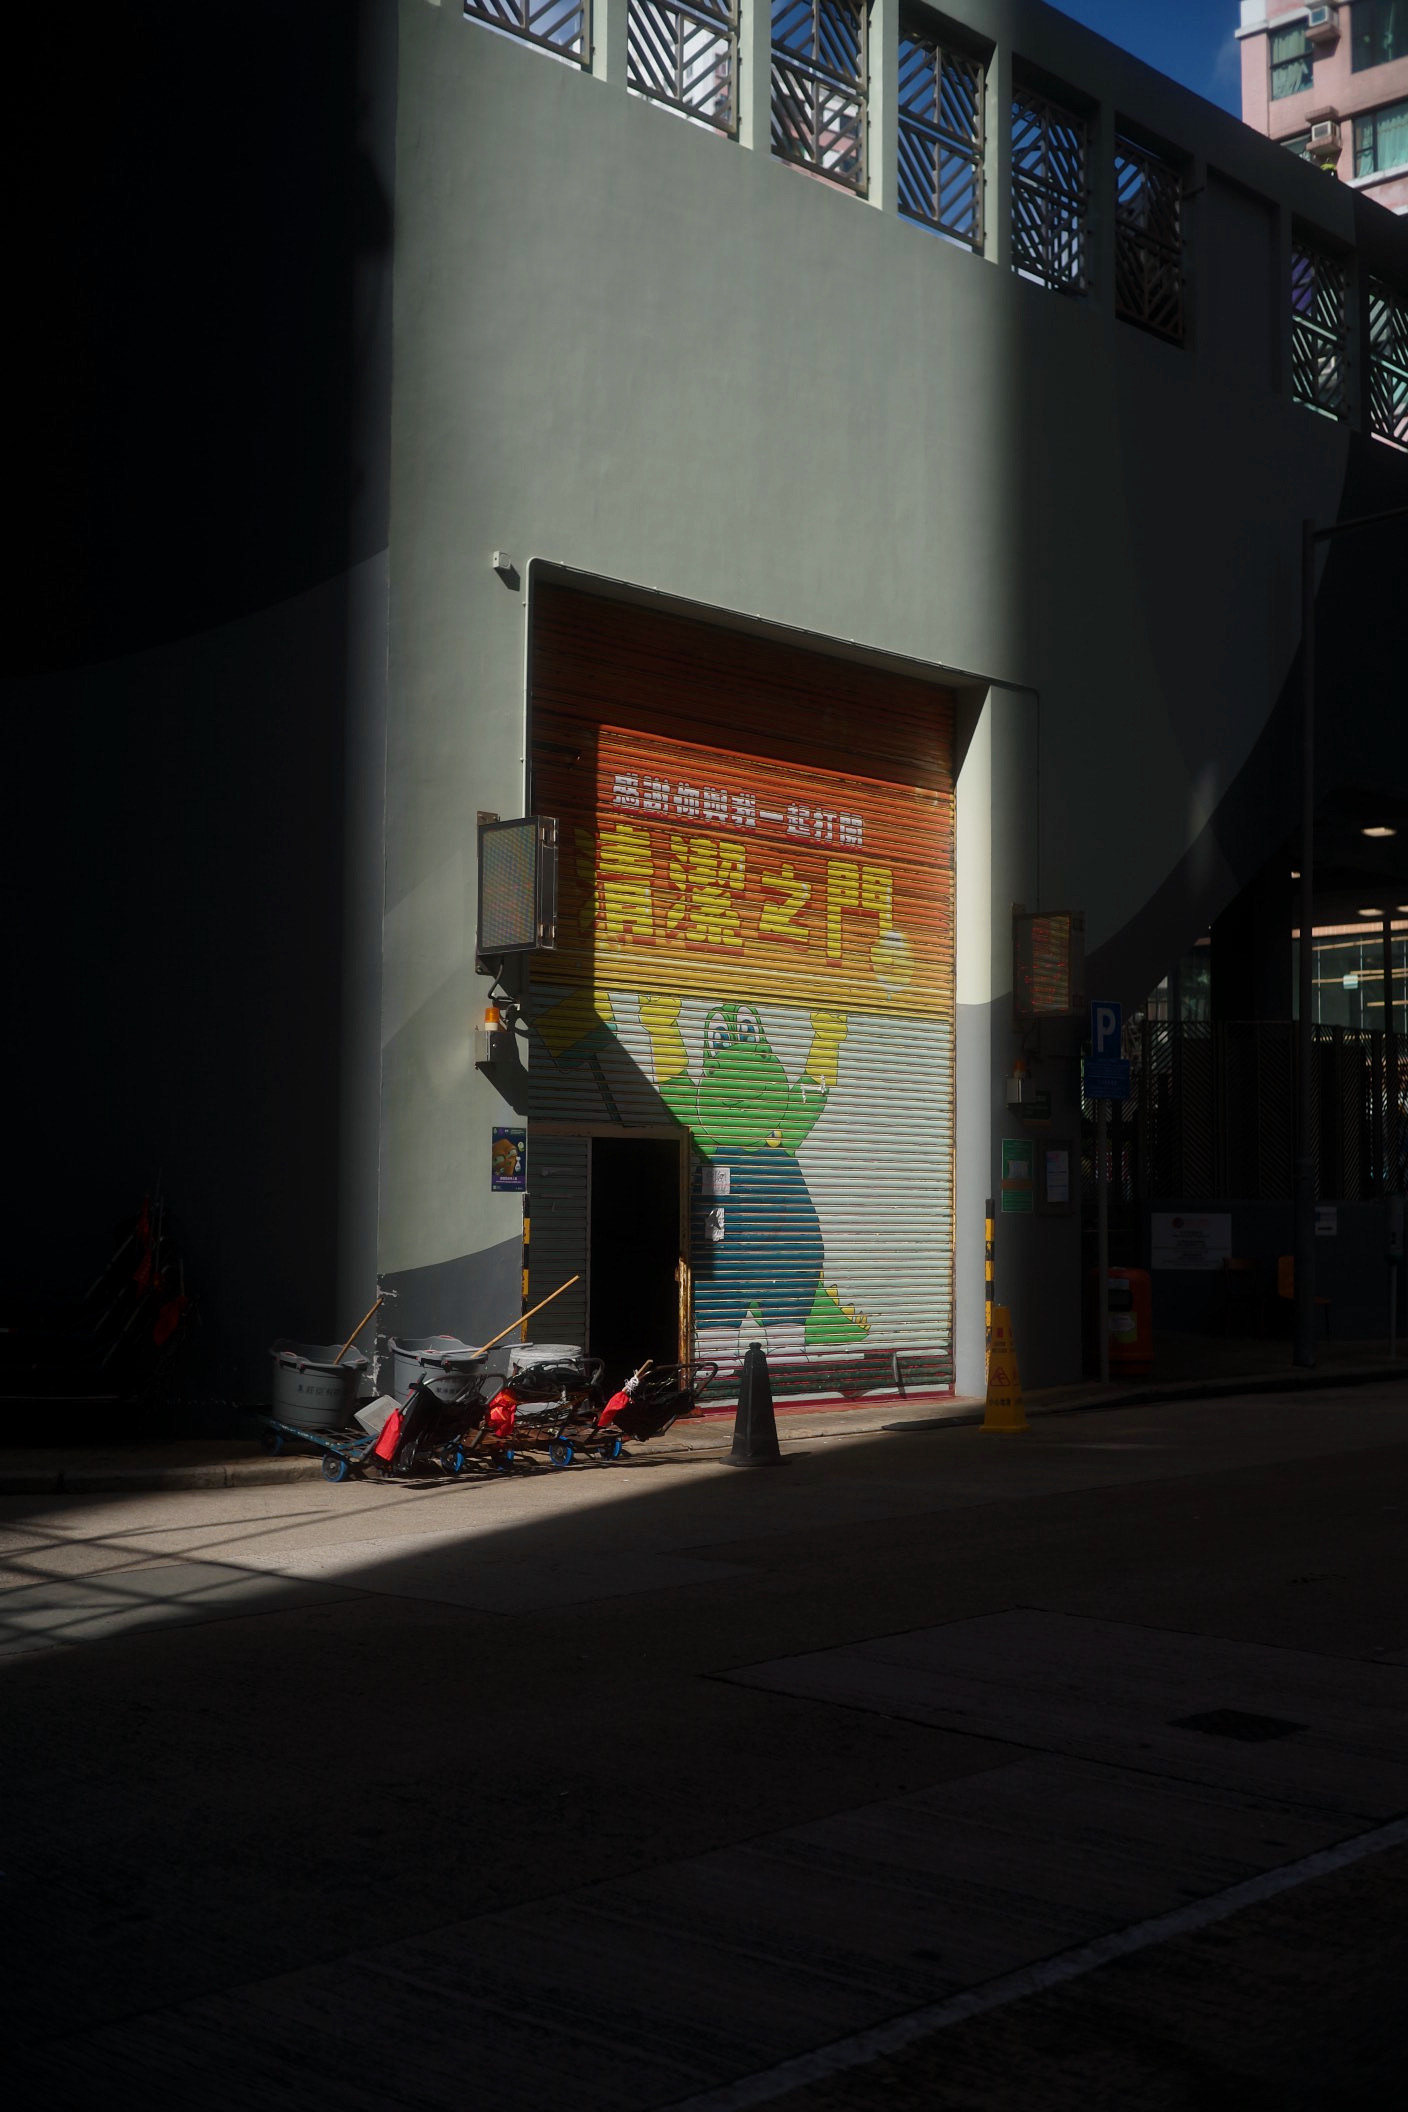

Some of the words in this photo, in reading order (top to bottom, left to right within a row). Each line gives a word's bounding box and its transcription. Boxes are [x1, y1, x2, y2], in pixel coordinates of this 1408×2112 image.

[574, 824, 893, 958] 清潔之門
[1096, 1007, 1117, 1053] P
